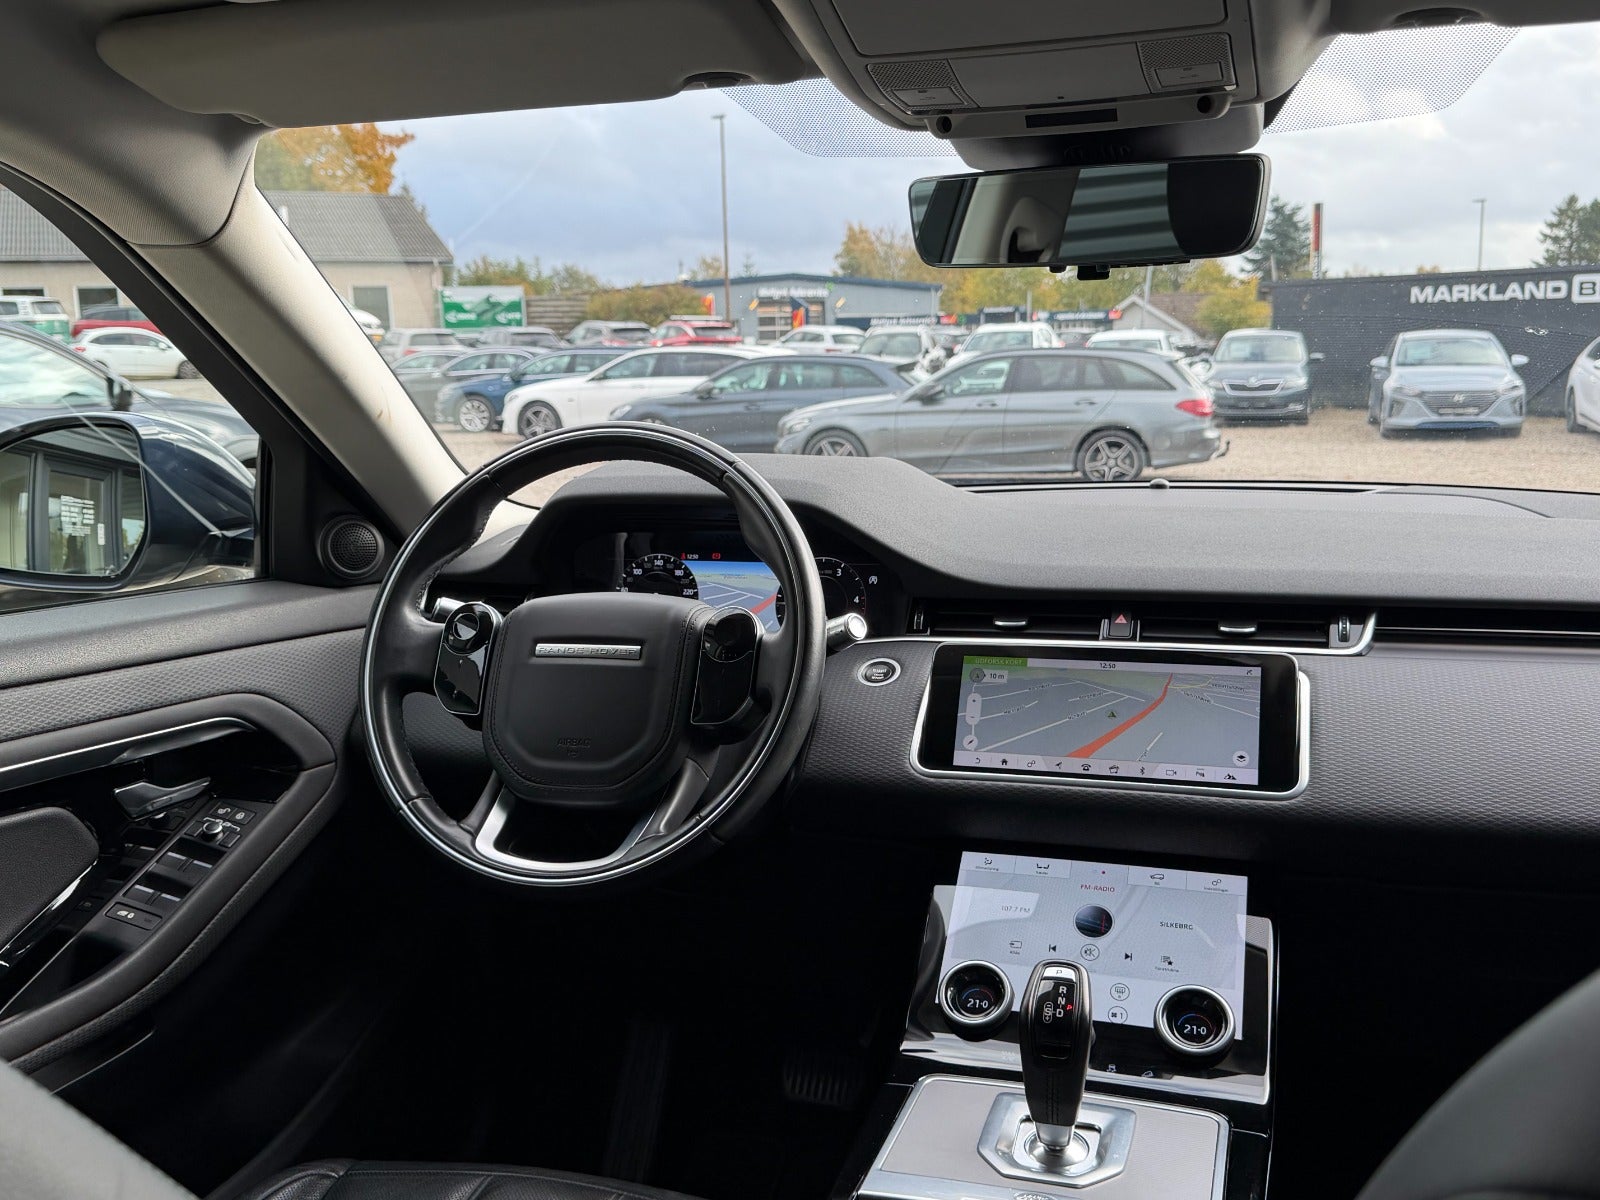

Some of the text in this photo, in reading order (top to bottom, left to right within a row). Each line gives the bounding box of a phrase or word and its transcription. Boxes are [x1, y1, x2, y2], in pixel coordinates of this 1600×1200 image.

[1409, 280, 1568, 304] MARKLAND
[836, 568, 842, 576] 3
[682, 588, 694, 596] 220
[853, 596, 860, 604] 4
[539, 646, 637, 656] RANGE ROVER
[1080, 884, 1115, 893] FM-RADIO
[1159, 921, 1194, 931] SILKEBRG
[1059, 985, 1067, 994] R
[1057, 996, 1066, 1005] N
[1044, 1007, 1064, 1018] S D
